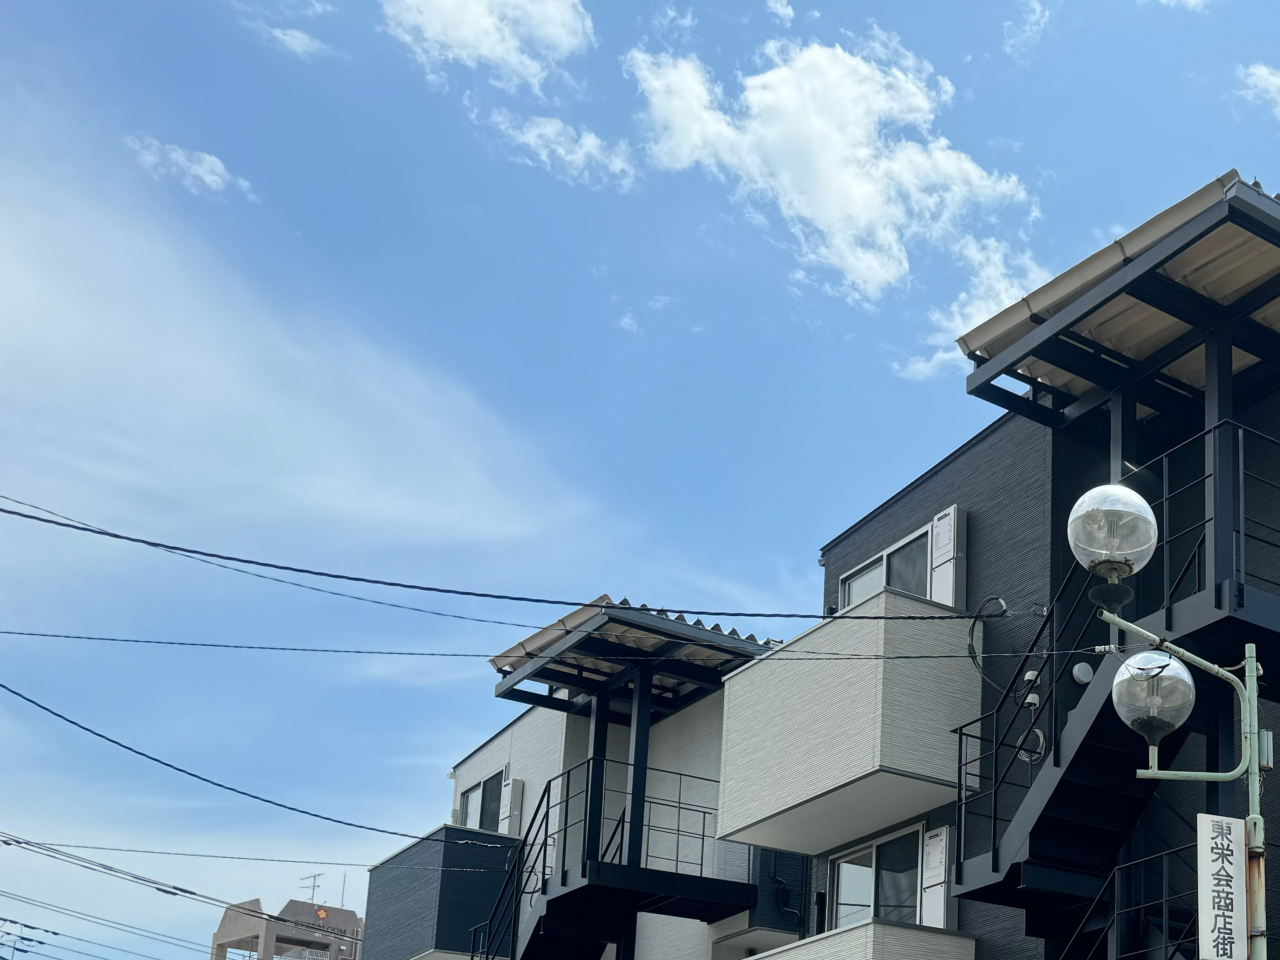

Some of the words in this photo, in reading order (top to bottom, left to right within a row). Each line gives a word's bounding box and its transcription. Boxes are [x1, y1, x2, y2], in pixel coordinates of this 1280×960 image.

[1210, 819, 1235, 959] 東栄会商店街
